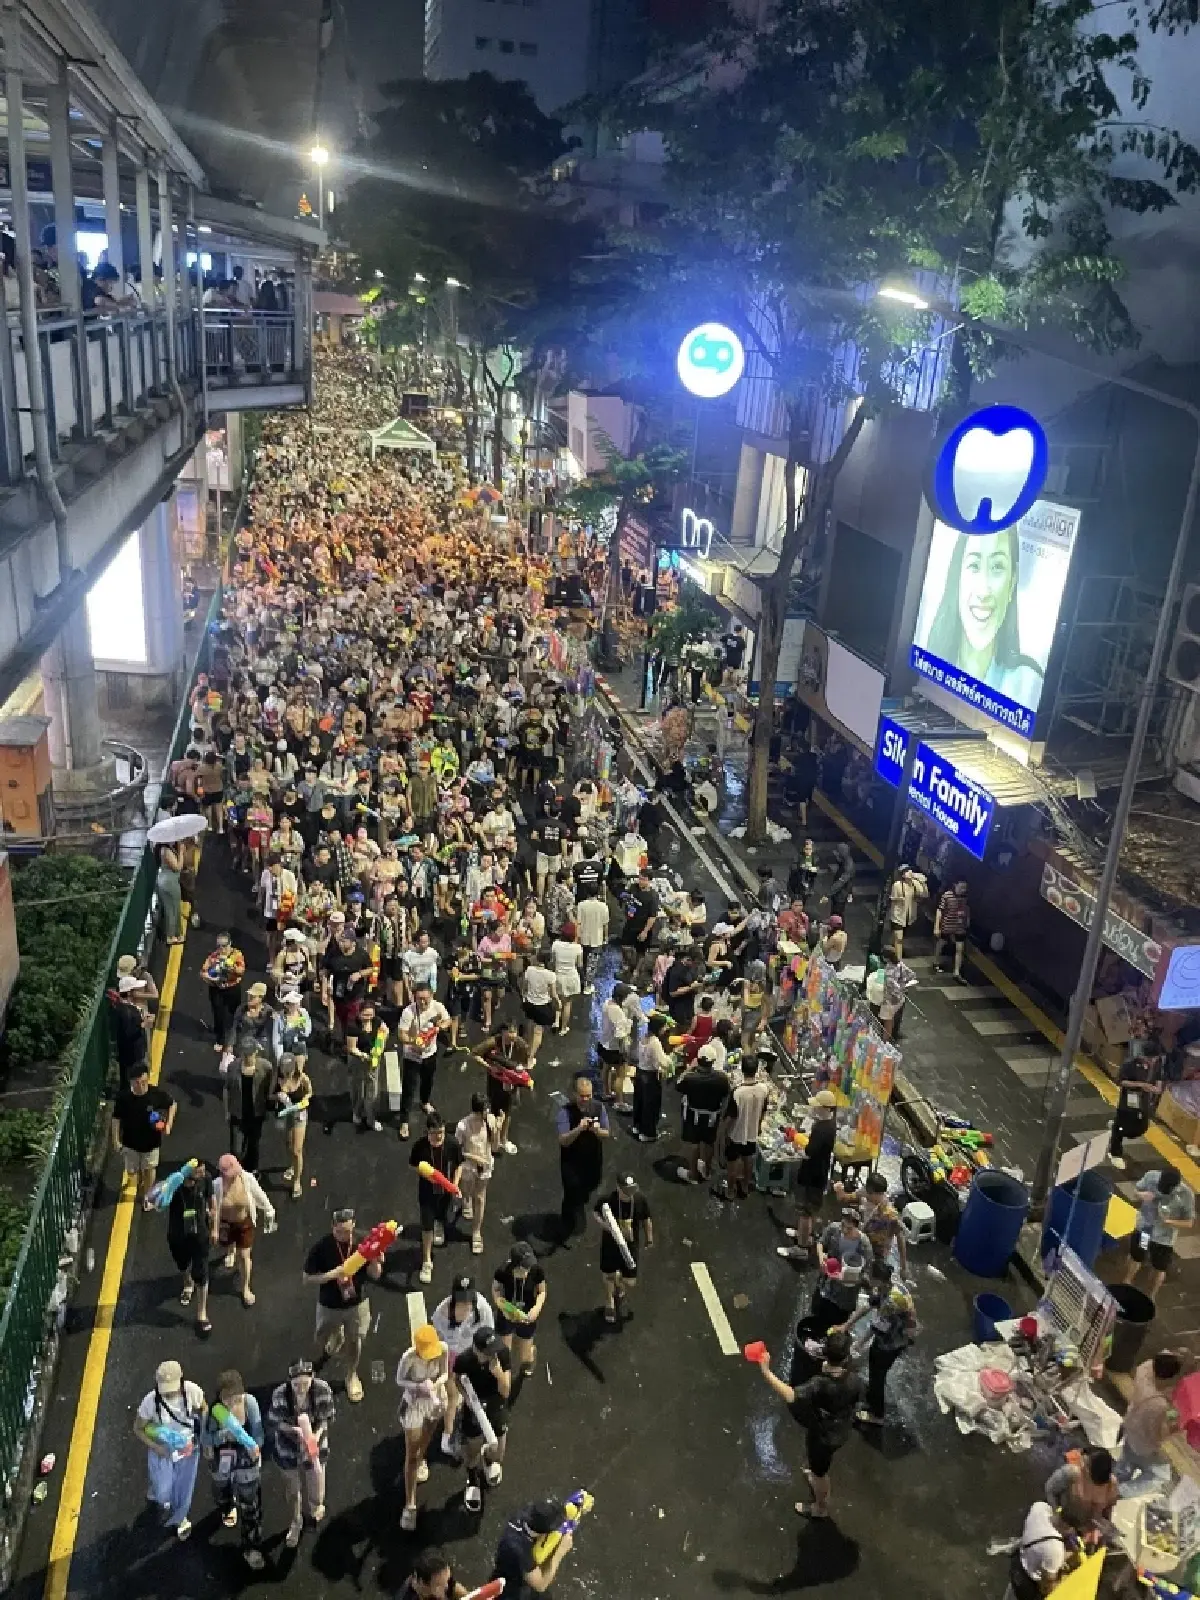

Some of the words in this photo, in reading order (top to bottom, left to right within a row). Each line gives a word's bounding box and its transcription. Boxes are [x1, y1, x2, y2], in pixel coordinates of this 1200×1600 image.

[909, 785, 931, 810] ental
[932, 802, 959, 834] House
[929, 766, 988, 836] Family
